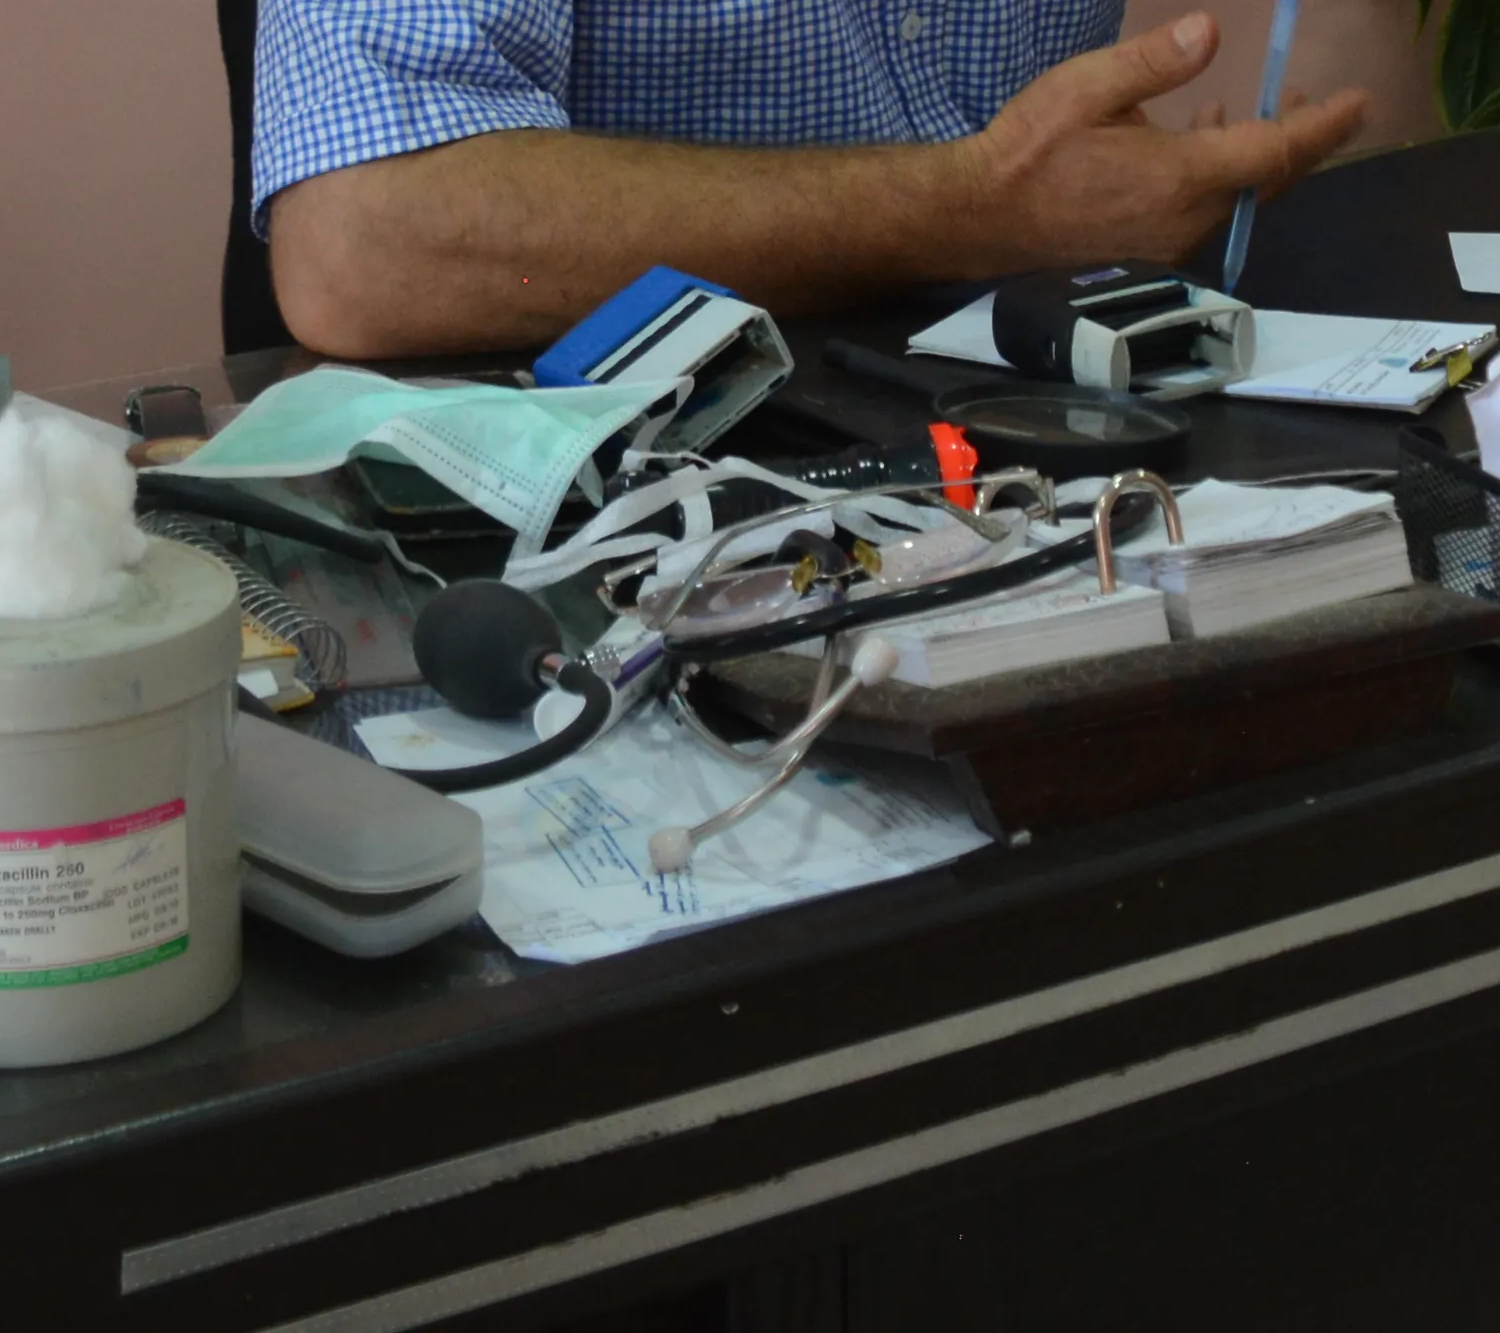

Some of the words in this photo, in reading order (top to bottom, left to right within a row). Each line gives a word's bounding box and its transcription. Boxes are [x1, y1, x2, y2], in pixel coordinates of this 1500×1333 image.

[27, 894, 70, 906] Sodium
[74, 890, 89, 901] BP
[3, 910, 15, 919] to
[58, 899, 115, 916] Cloxacillin
[24, 925, 56, 936] ORALLY
